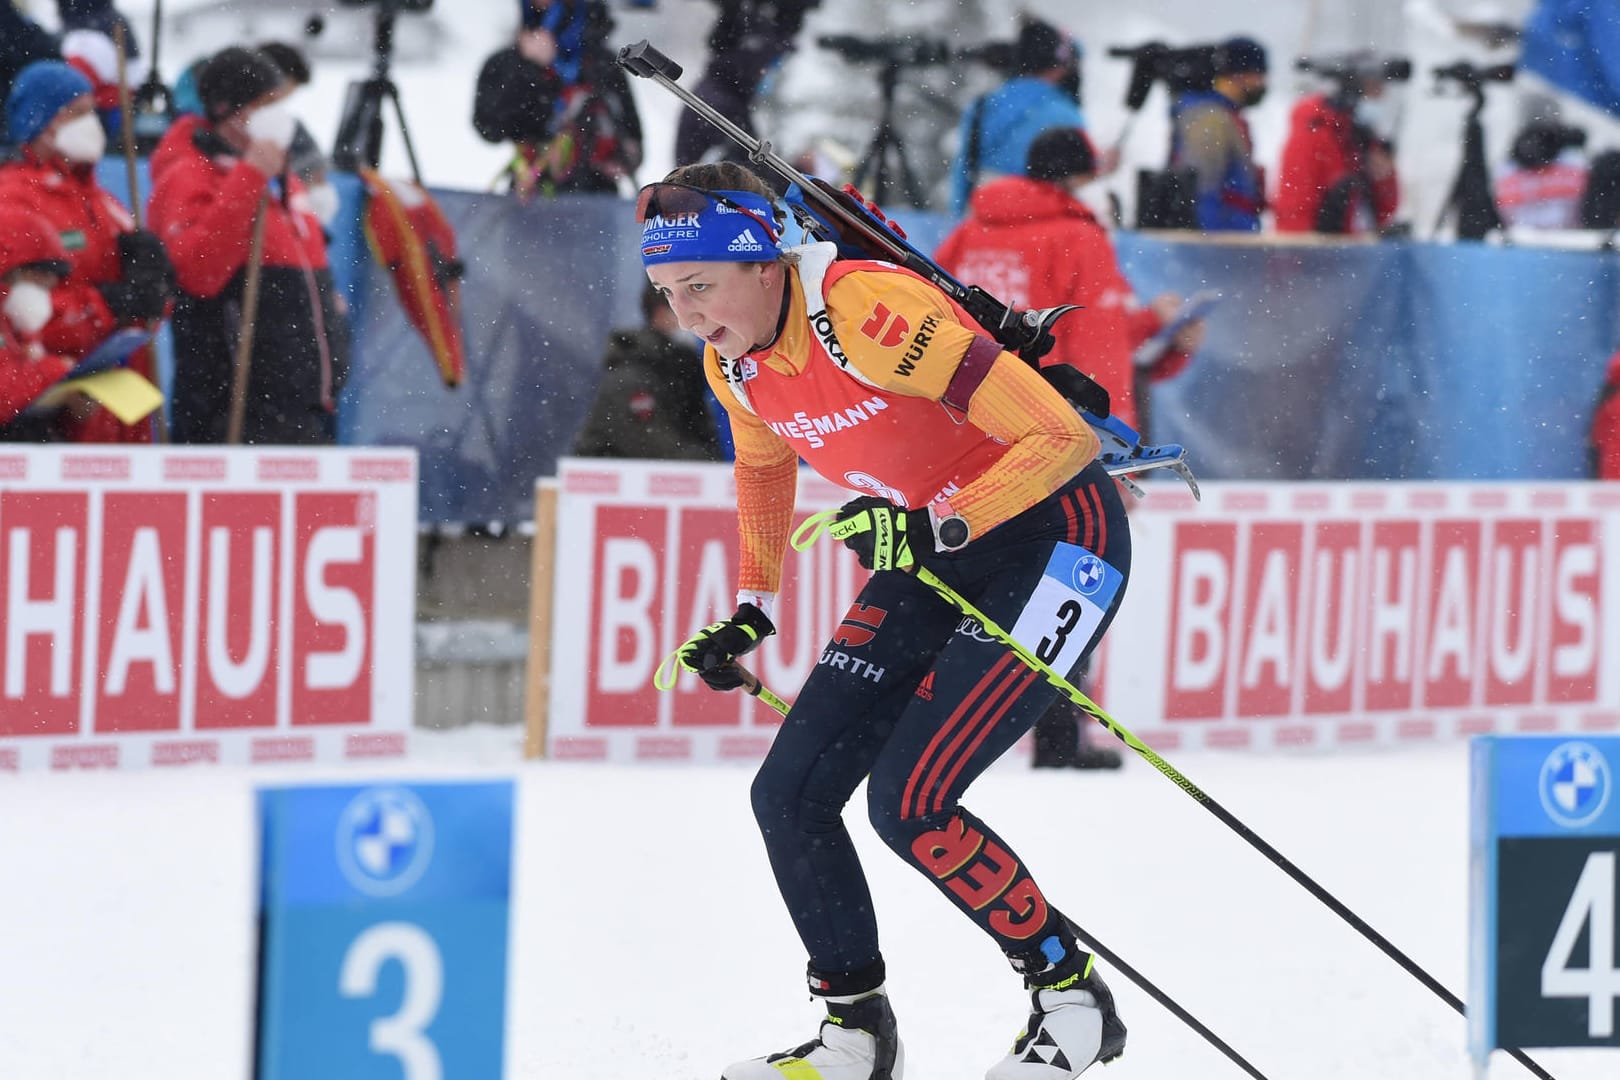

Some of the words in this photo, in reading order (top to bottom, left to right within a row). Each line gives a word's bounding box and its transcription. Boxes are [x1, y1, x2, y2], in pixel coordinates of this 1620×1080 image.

[727, 243, 763, 252] adidas
[809, 310, 848, 368] JOKA
[894, 314, 941, 378] WÜRTH
[764, 396, 889, 449] VIESSMANN
[4, 525, 367, 698] HAUS
[1035, 599, 1083, 667] 3
[1172, 544, 1598, 692] BAUHAUS
[911, 815, 1048, 940] GER
[1540, 849, 1620, 1038] 4
[338, 919, 445, 1080] 3
